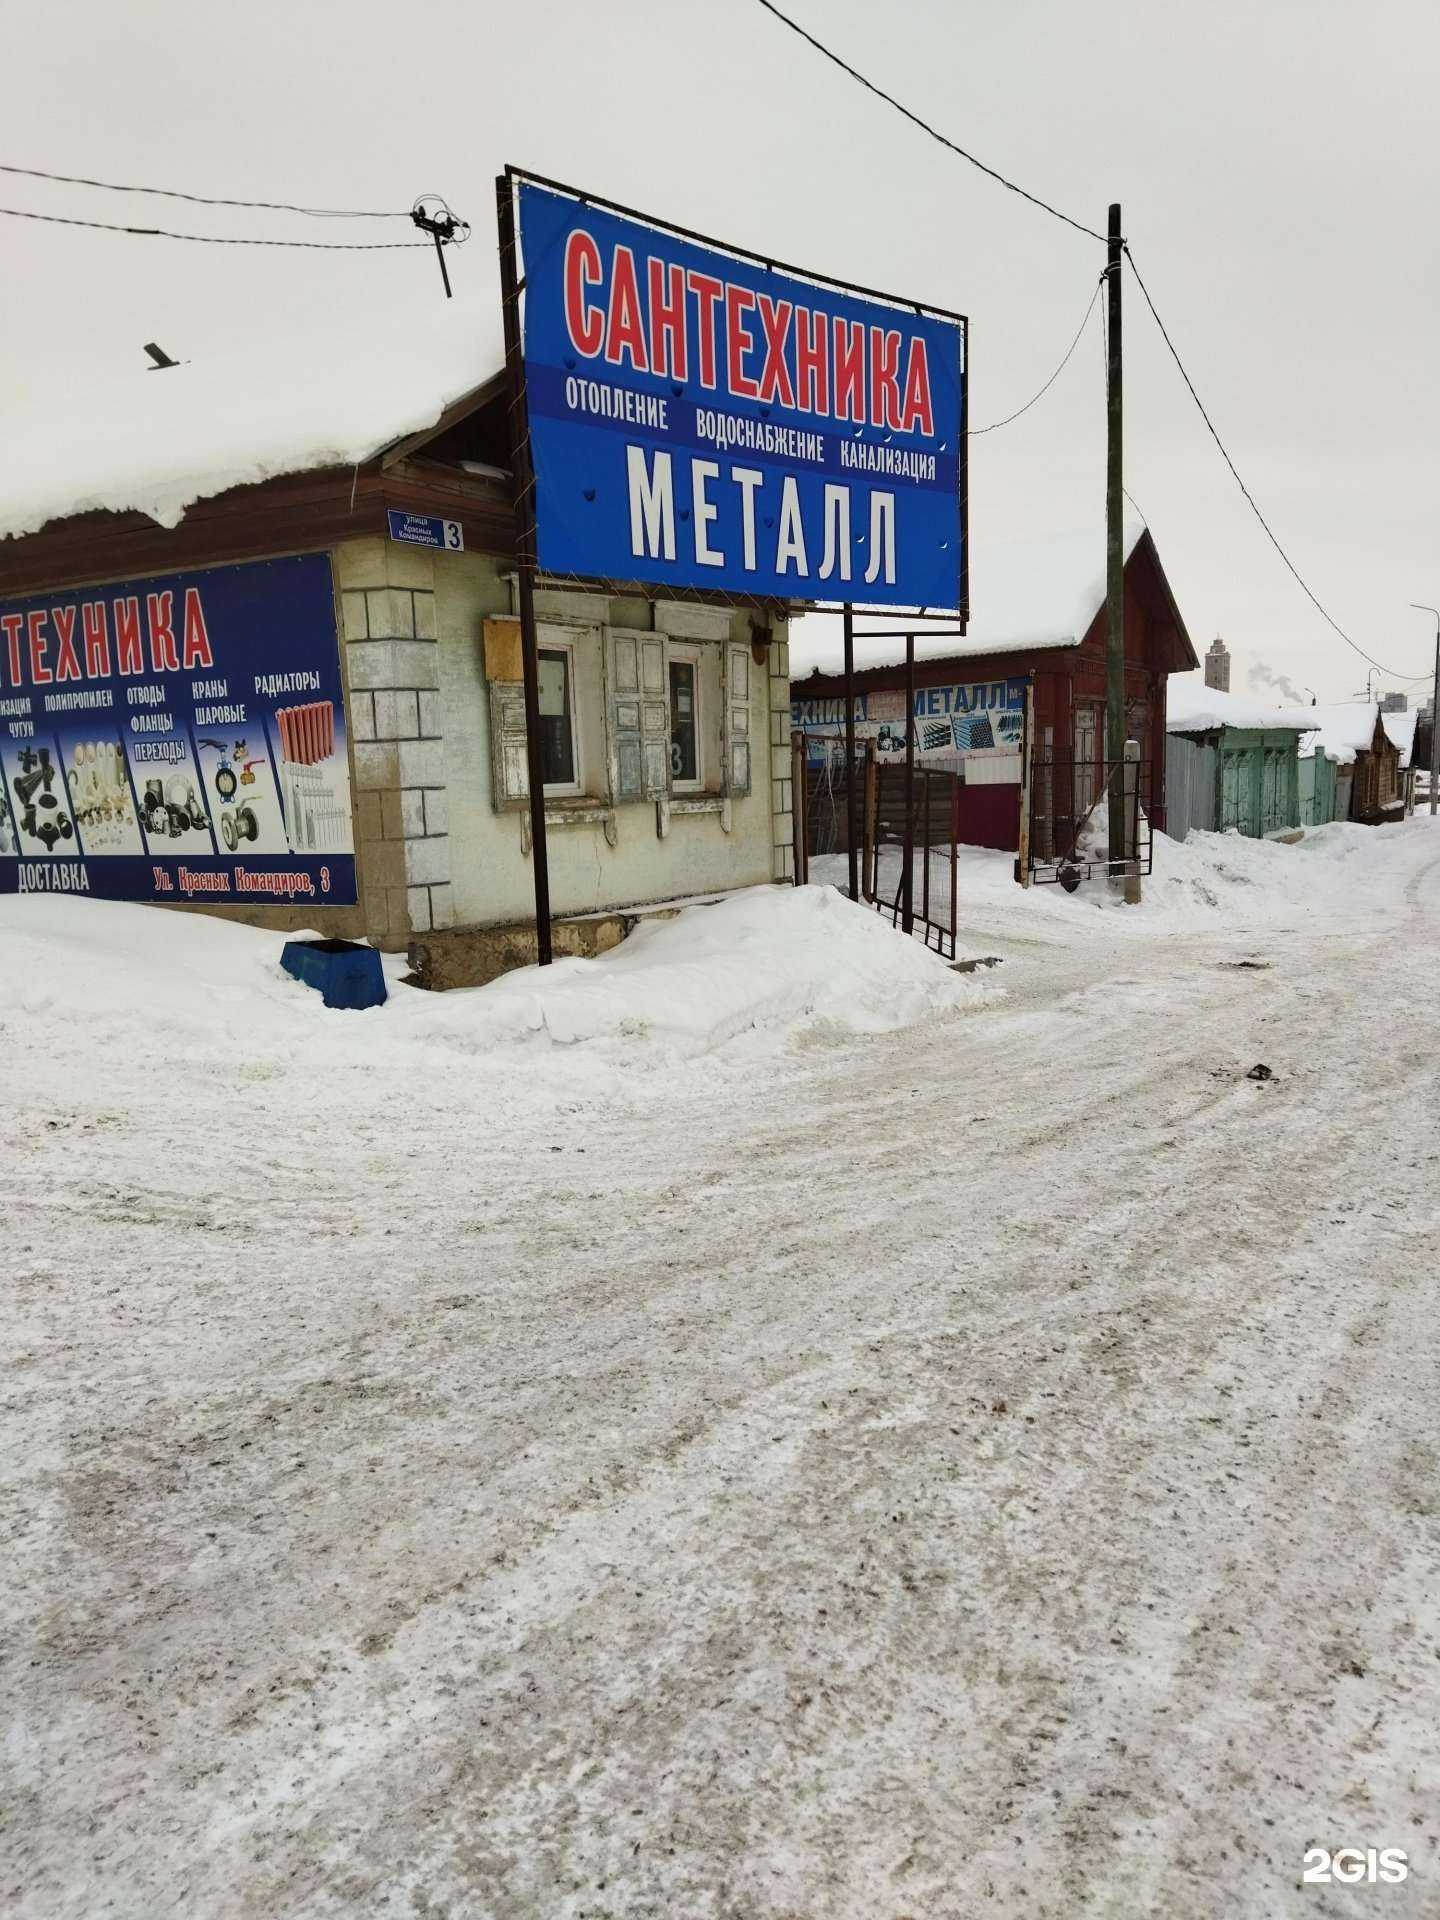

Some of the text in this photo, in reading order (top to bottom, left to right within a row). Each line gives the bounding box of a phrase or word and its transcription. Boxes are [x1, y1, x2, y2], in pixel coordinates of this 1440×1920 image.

[563, 228, 935, 438] САНТЕХНИКА
[566, 376, 936, 483] ОТОПЛЕНИЕ ВОДОСНАБЖЕНИЕ КАНАЛИЗАЦИЯ
[626, 444, 897, 585] МЕТАЛЛ
[448, 523, 461, 548] 3
[0, 588, 214, 687] ТЕХНИКА
[192, 680, 228, 699] КРАНЫ
[255, 671, 321, 695] РАДИАТОРЫ
[45, 690, 114, 713] ПОЛИПРОПИЛЕН
[127, 685, 166, 706] ОТВОДЫ
[131, 713, 174, 735] ФЛАНЦЫ
[195, 704, 248, 725] ШАРОВЫЕ
[9, 721, 35, 738] ЧУГУН
[134, 740, 186, 764] ПЕРЕХОДЫ
[18, 862, 90, 894] ДОСТАВКА
[153, 866, 331, 896] Ул. Красных Командиров, 3
